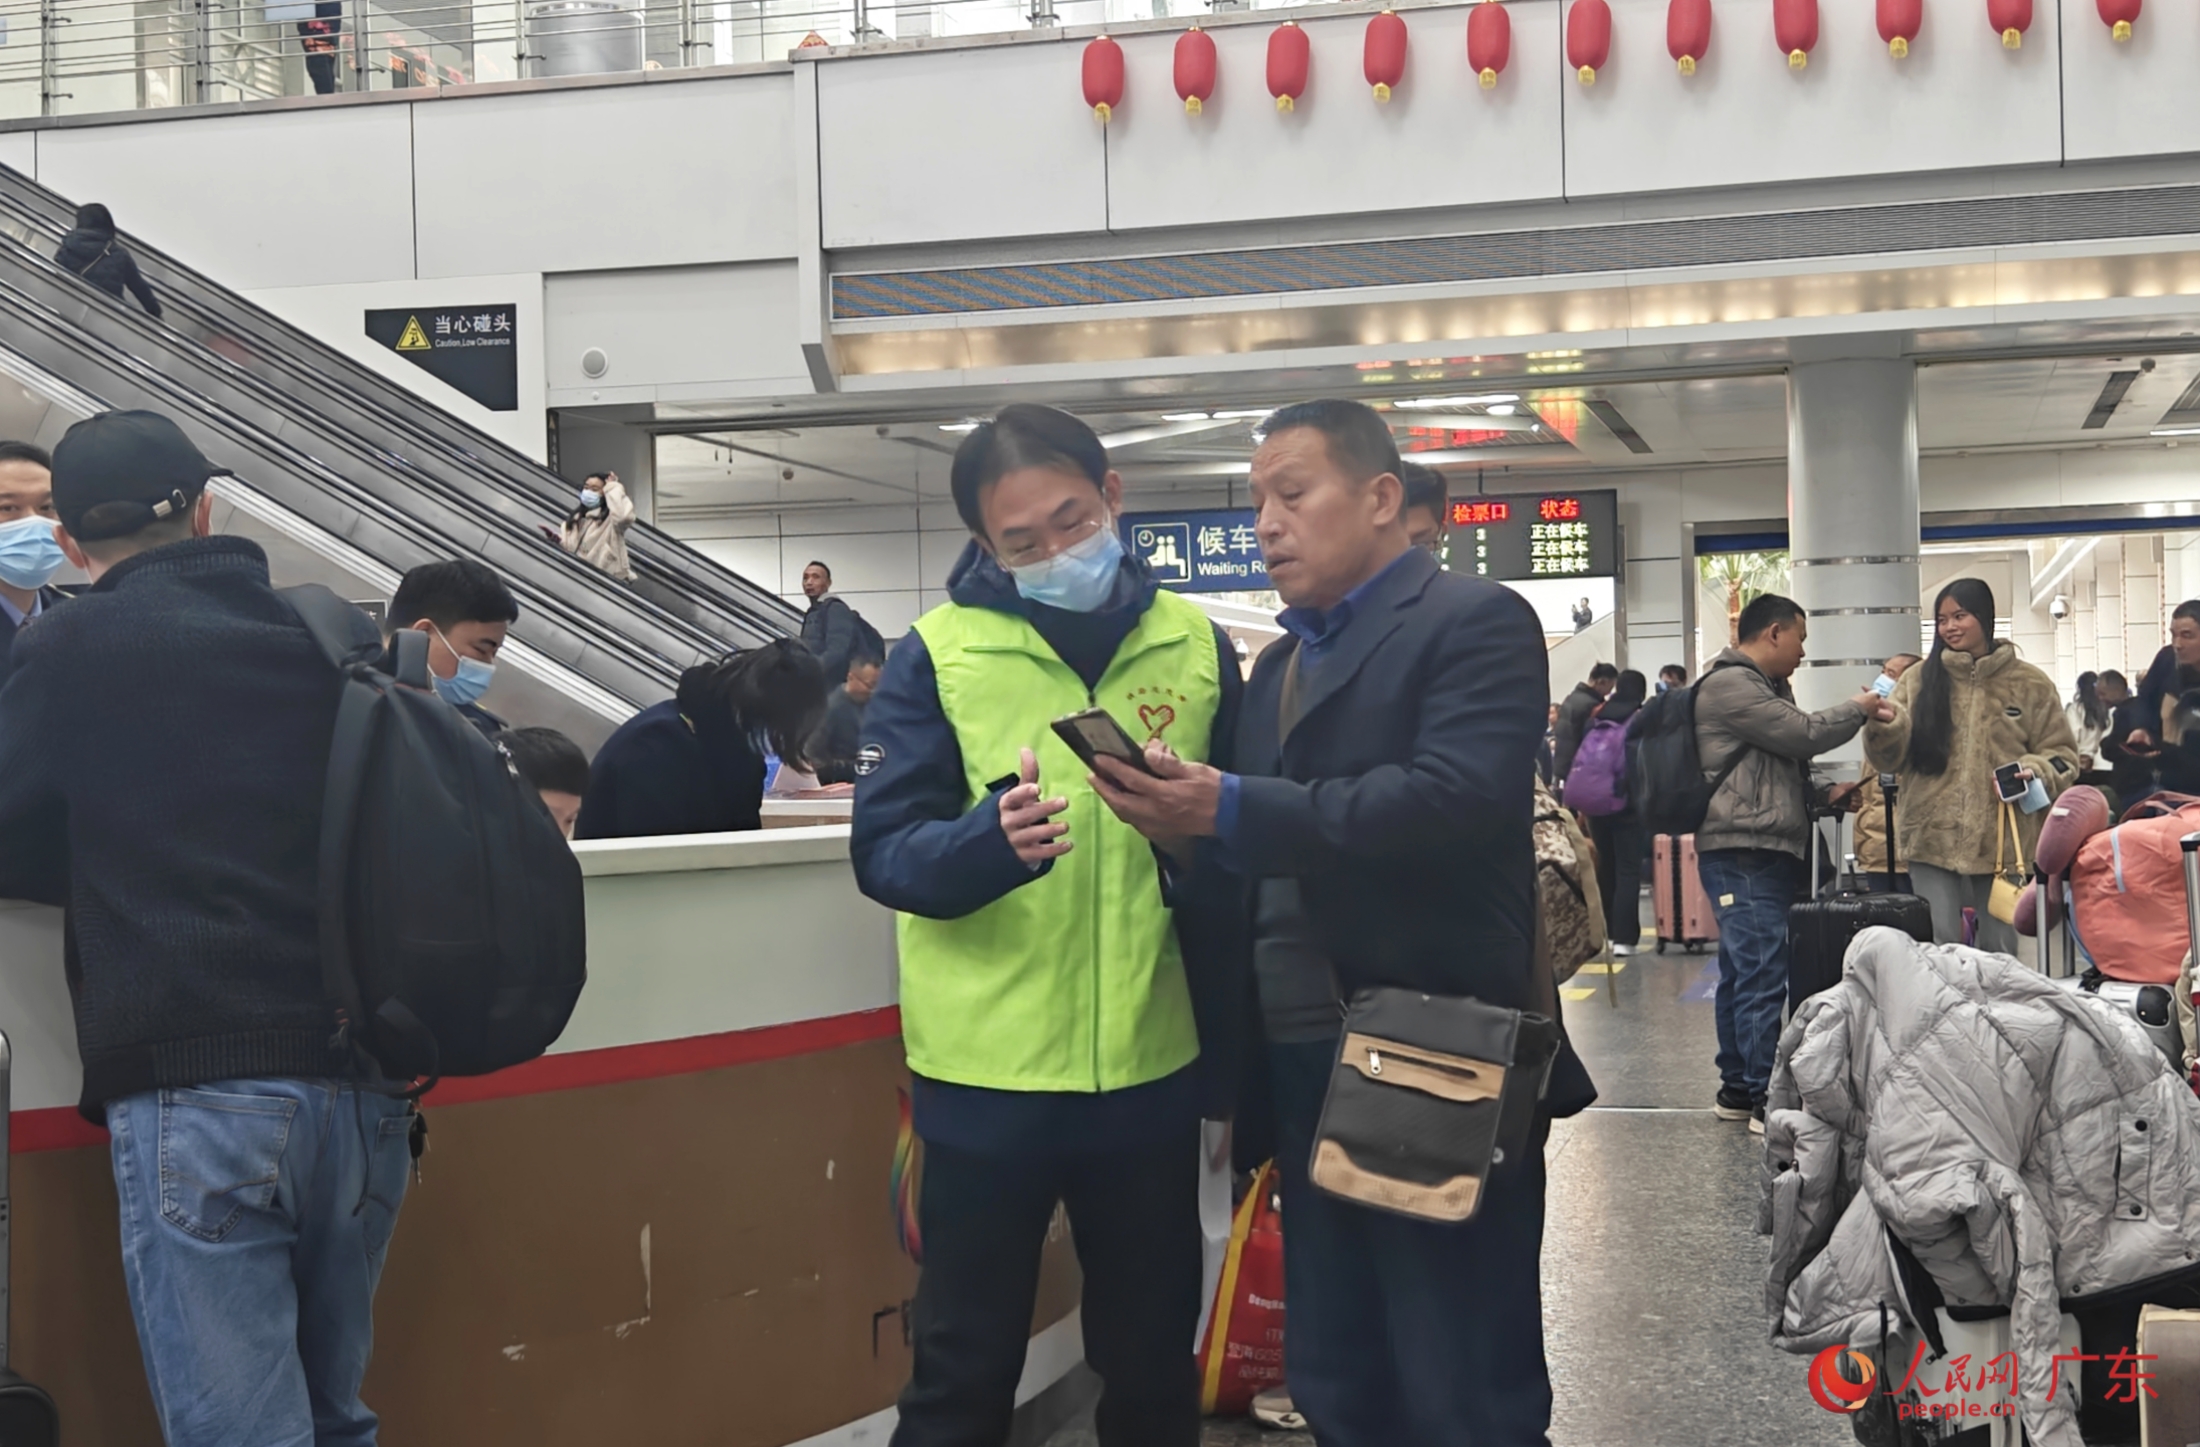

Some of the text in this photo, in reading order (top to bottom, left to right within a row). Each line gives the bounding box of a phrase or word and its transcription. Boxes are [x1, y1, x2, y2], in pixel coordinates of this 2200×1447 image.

[435, 313, 511, 334] 当心碰头
[477, 337, 511, 346] Clearance
[1453, 499, 1579, 523] 检票口 状态
[1197, 524, 1257, 556] 候车
[1476, 522, 1589, 541] 3 正在候车
[1476, 539, 1589, 558] 3 正在候车
[1197, 562, 1248, 577] Waiting
[1477, 556, 1590, 575] 3 正在候车
